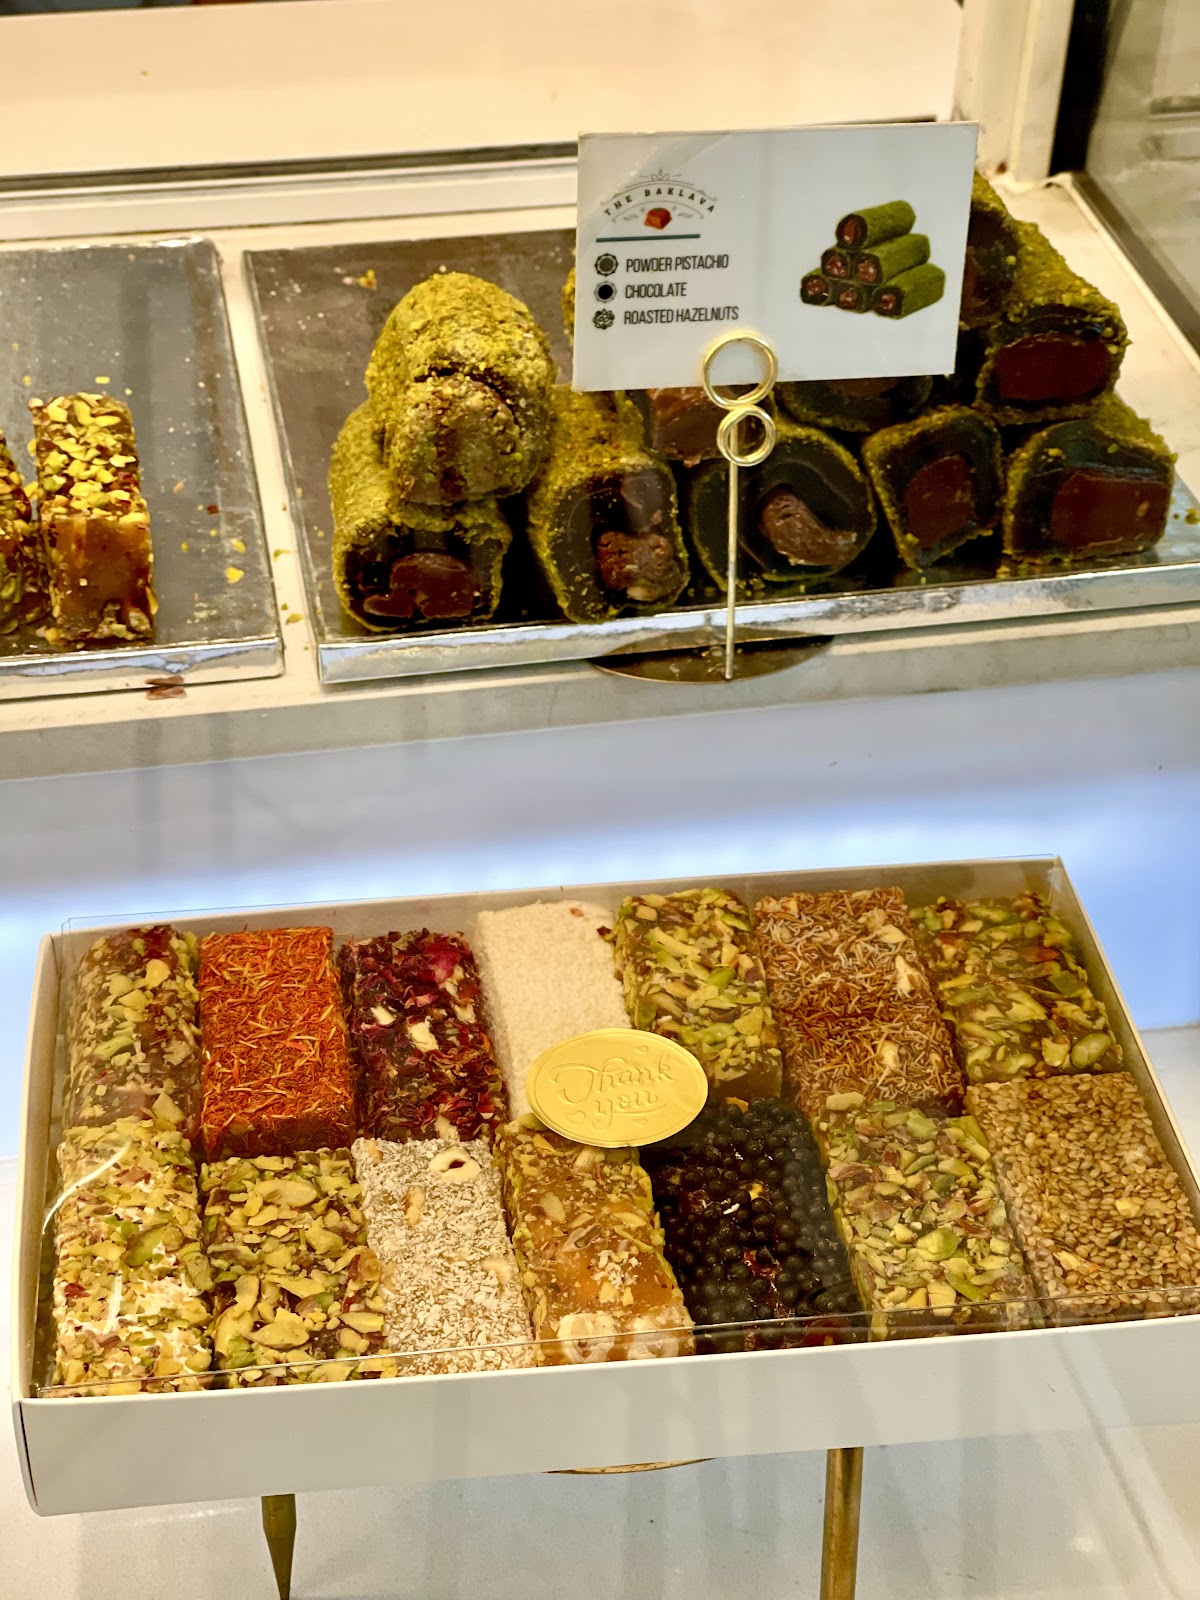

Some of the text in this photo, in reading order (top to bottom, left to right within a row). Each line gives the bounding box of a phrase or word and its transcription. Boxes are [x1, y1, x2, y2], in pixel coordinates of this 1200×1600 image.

[604, 187, 715, 216] THE BAKLAVA
[626, 254, 730, 273] POWDER PISTACHIO
[625, 282, 688, 299] CHOCOLATE
[624, 306, 740, 325] ROASTED HAZELNUTS
[548, 1051, 676, 1105] Thank
[592, 1089, 667, 1131] you
